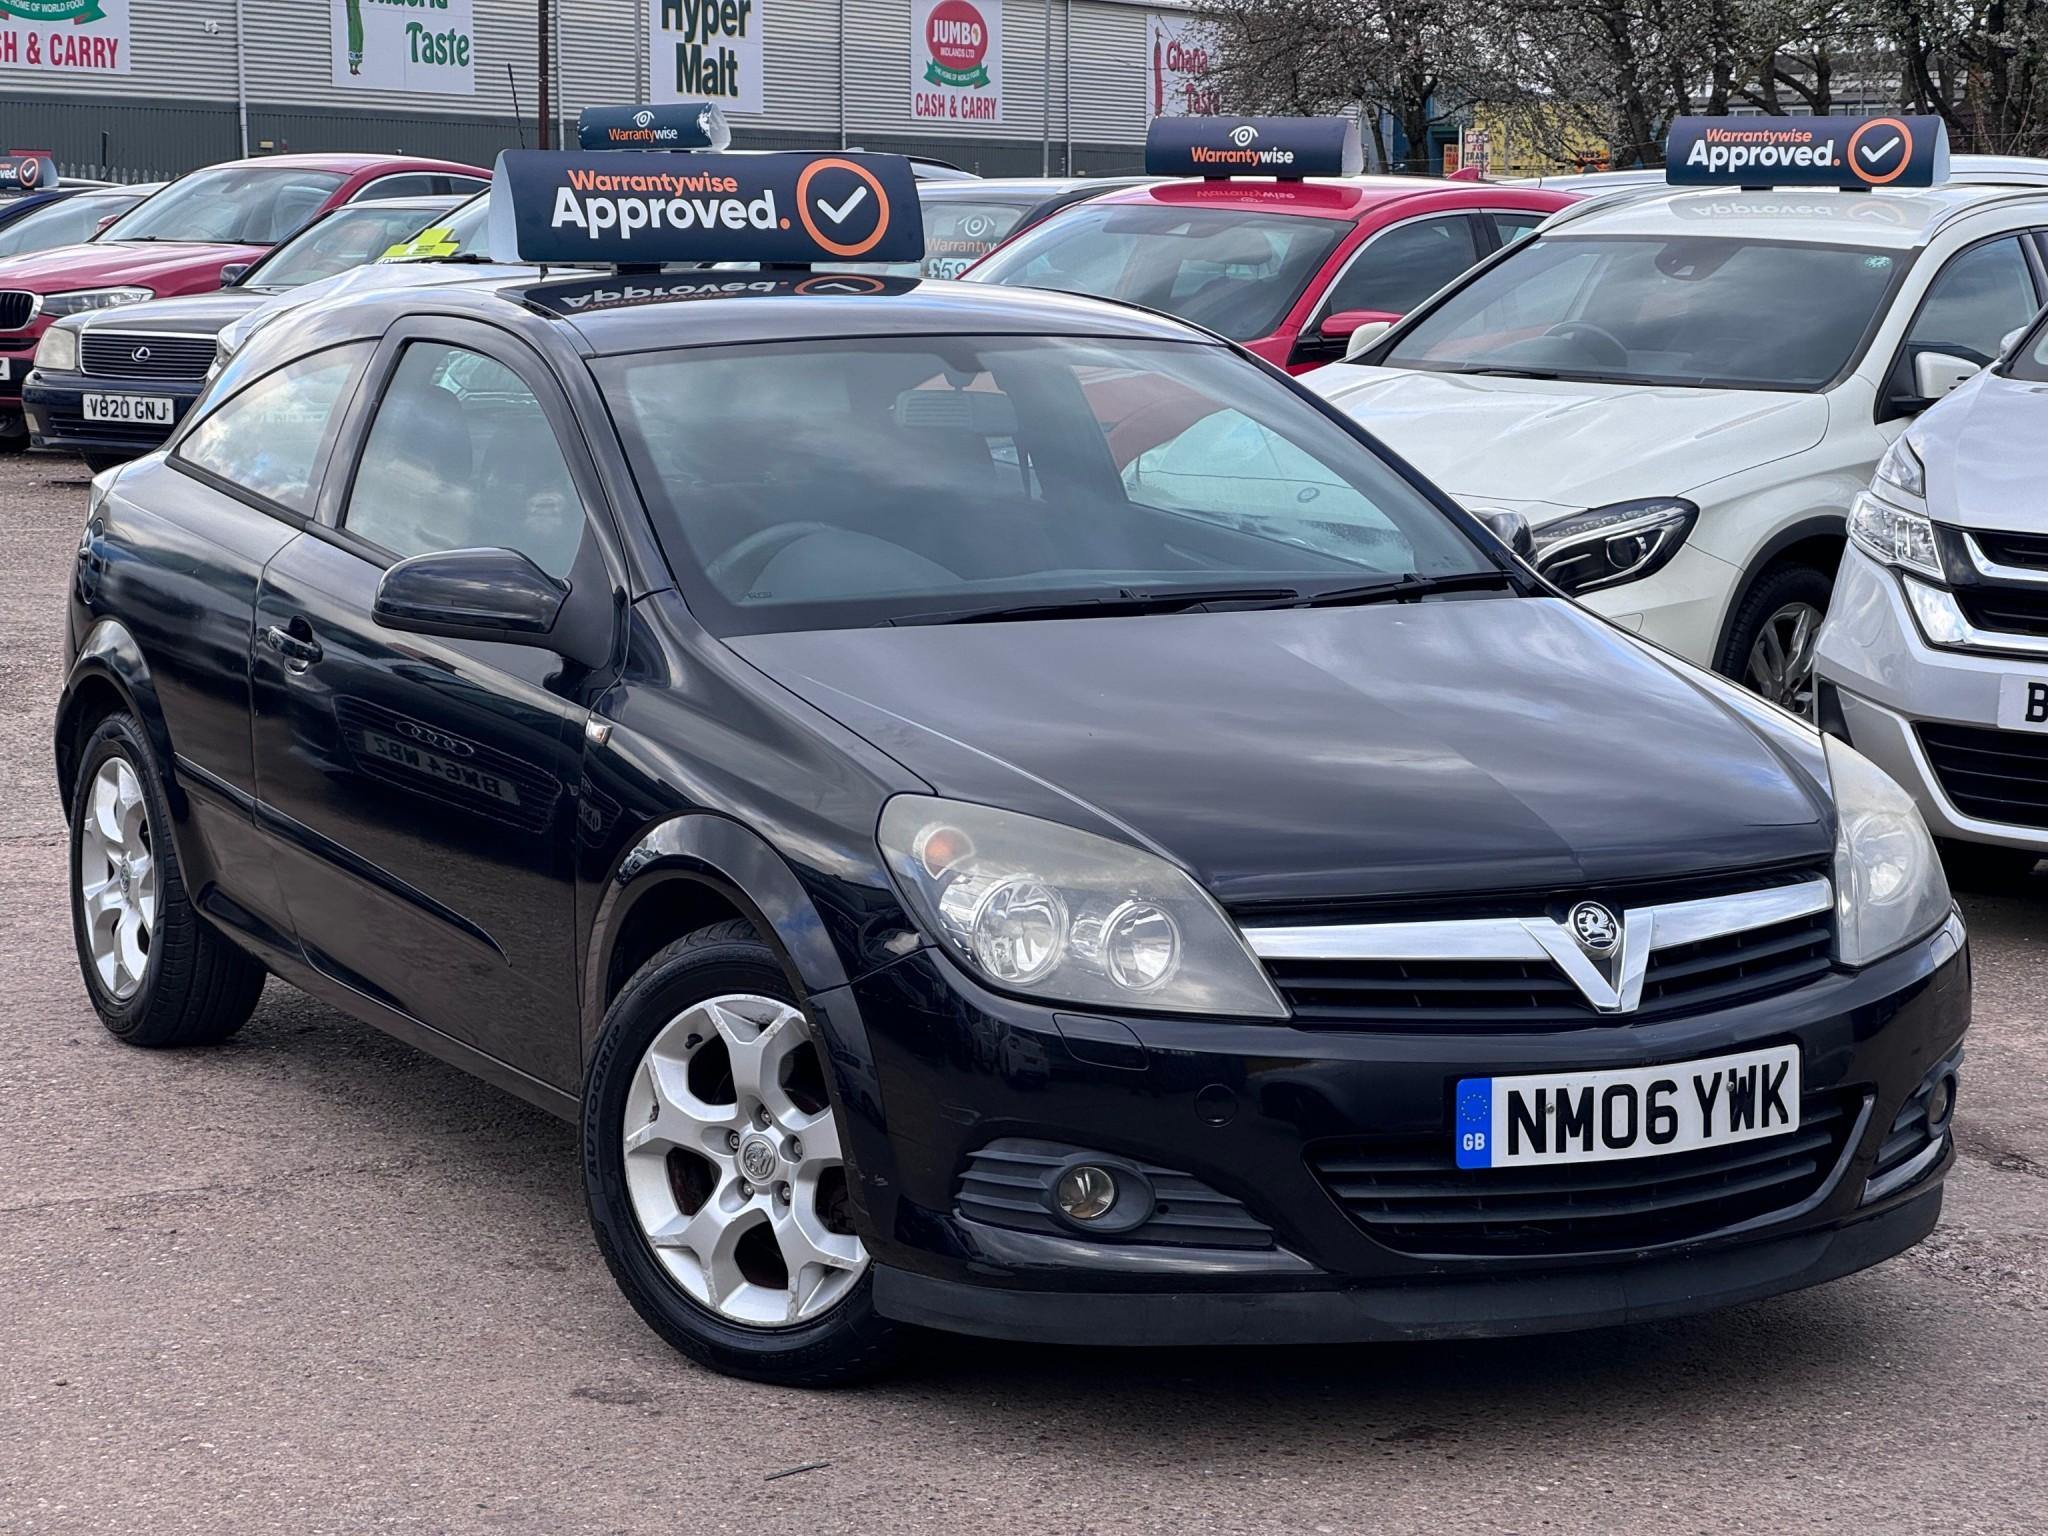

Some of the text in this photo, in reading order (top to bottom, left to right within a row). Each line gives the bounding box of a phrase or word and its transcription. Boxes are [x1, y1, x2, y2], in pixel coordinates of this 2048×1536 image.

[31, 3, 41, 11] OF
[42, 3, 66, 13] WORLD
[661, 0, 752, 45] Hyper
[405, 22, 470, 67] Taste
[932, 19, 982, 46] JUMBO
[27, 32, 41, 64] &
[50, 34, 119, 69] CARRY
[1166, 40, 1208, 74] Ghana
[676, 42, 738, 97] Malt
[915, 92, 997, 120] CASH & CARRY
[608, 126, 678, 143] Warrantywise
[1705, 128, 1812, 145] Warrantywise
[1191, 146, 1294, 166] Warrantywise
[1686, 139, 1840, 172] Approved.
[567, 169, 738, 197] Warrantywise
[551, 186, 791, 239] Approved.
[89, 398, 166, 420] V820 GNJ
[586, 1023, 621, 1182] AUTOGRIP
[1507, 1060, 1789, 1156] NM06 YWK
[1462, 1132, 1486, 1151] GB
